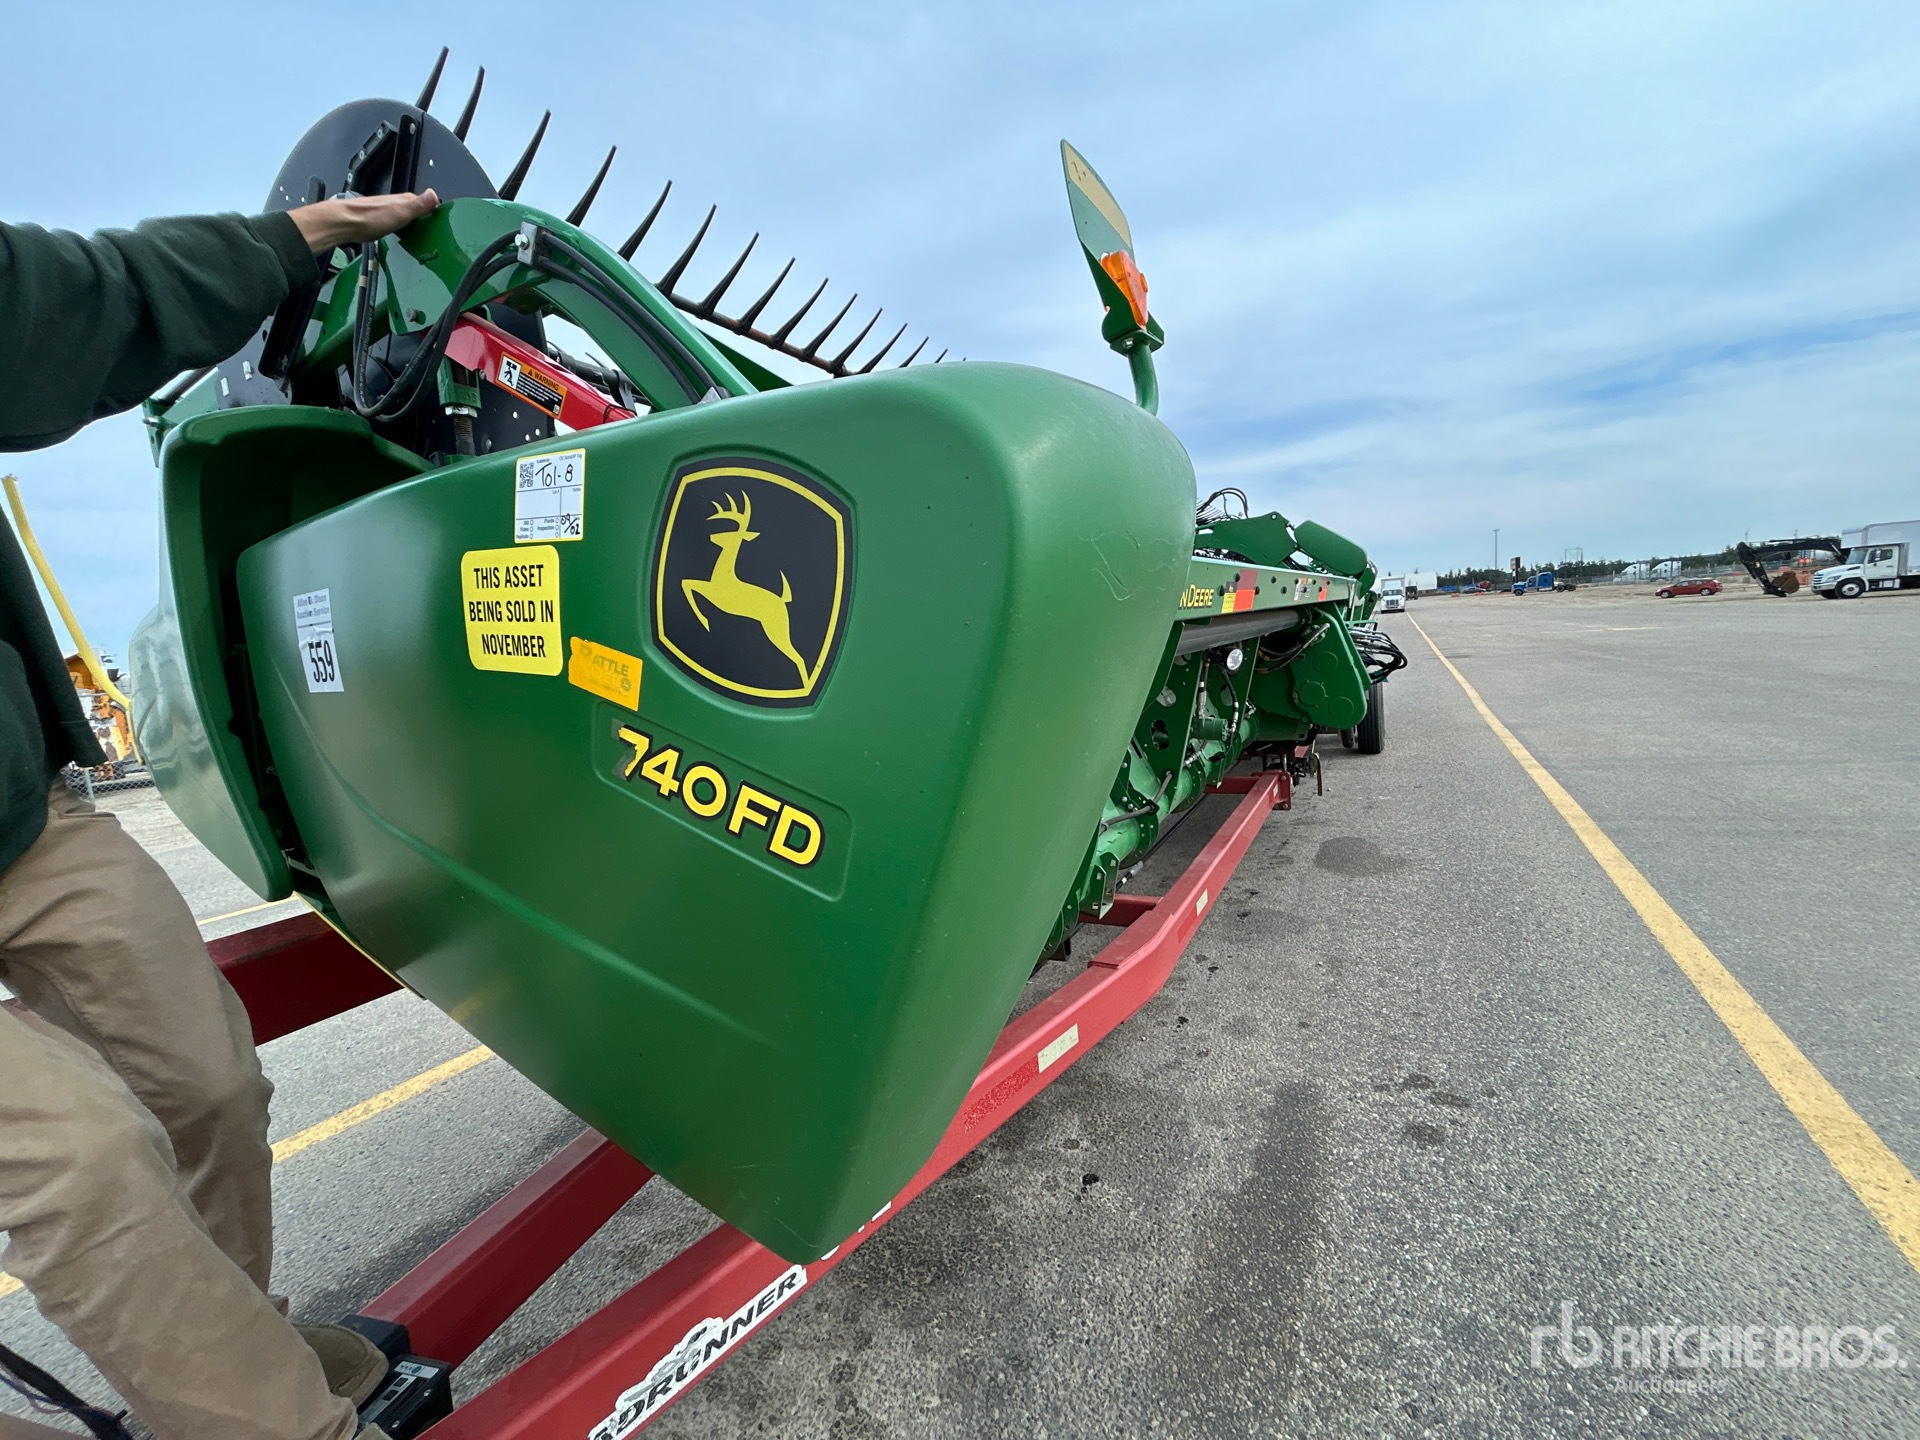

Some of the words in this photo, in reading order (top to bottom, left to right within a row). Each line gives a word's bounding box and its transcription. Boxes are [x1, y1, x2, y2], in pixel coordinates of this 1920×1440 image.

[534, 370, 559, 391] WARNING
[473, 566, 500, 589] THIS
[504, 564, 544, 588] ASSET
[468, 601, 503, 622] BEING
[505, 600, 536, 622] SOLD
[540, 600, 554, 622] IN
[481, 634, 546, 658] NOVEMBER
[308, 639, 335, 683] 559
[617, 725, 824, 868] 740FD
